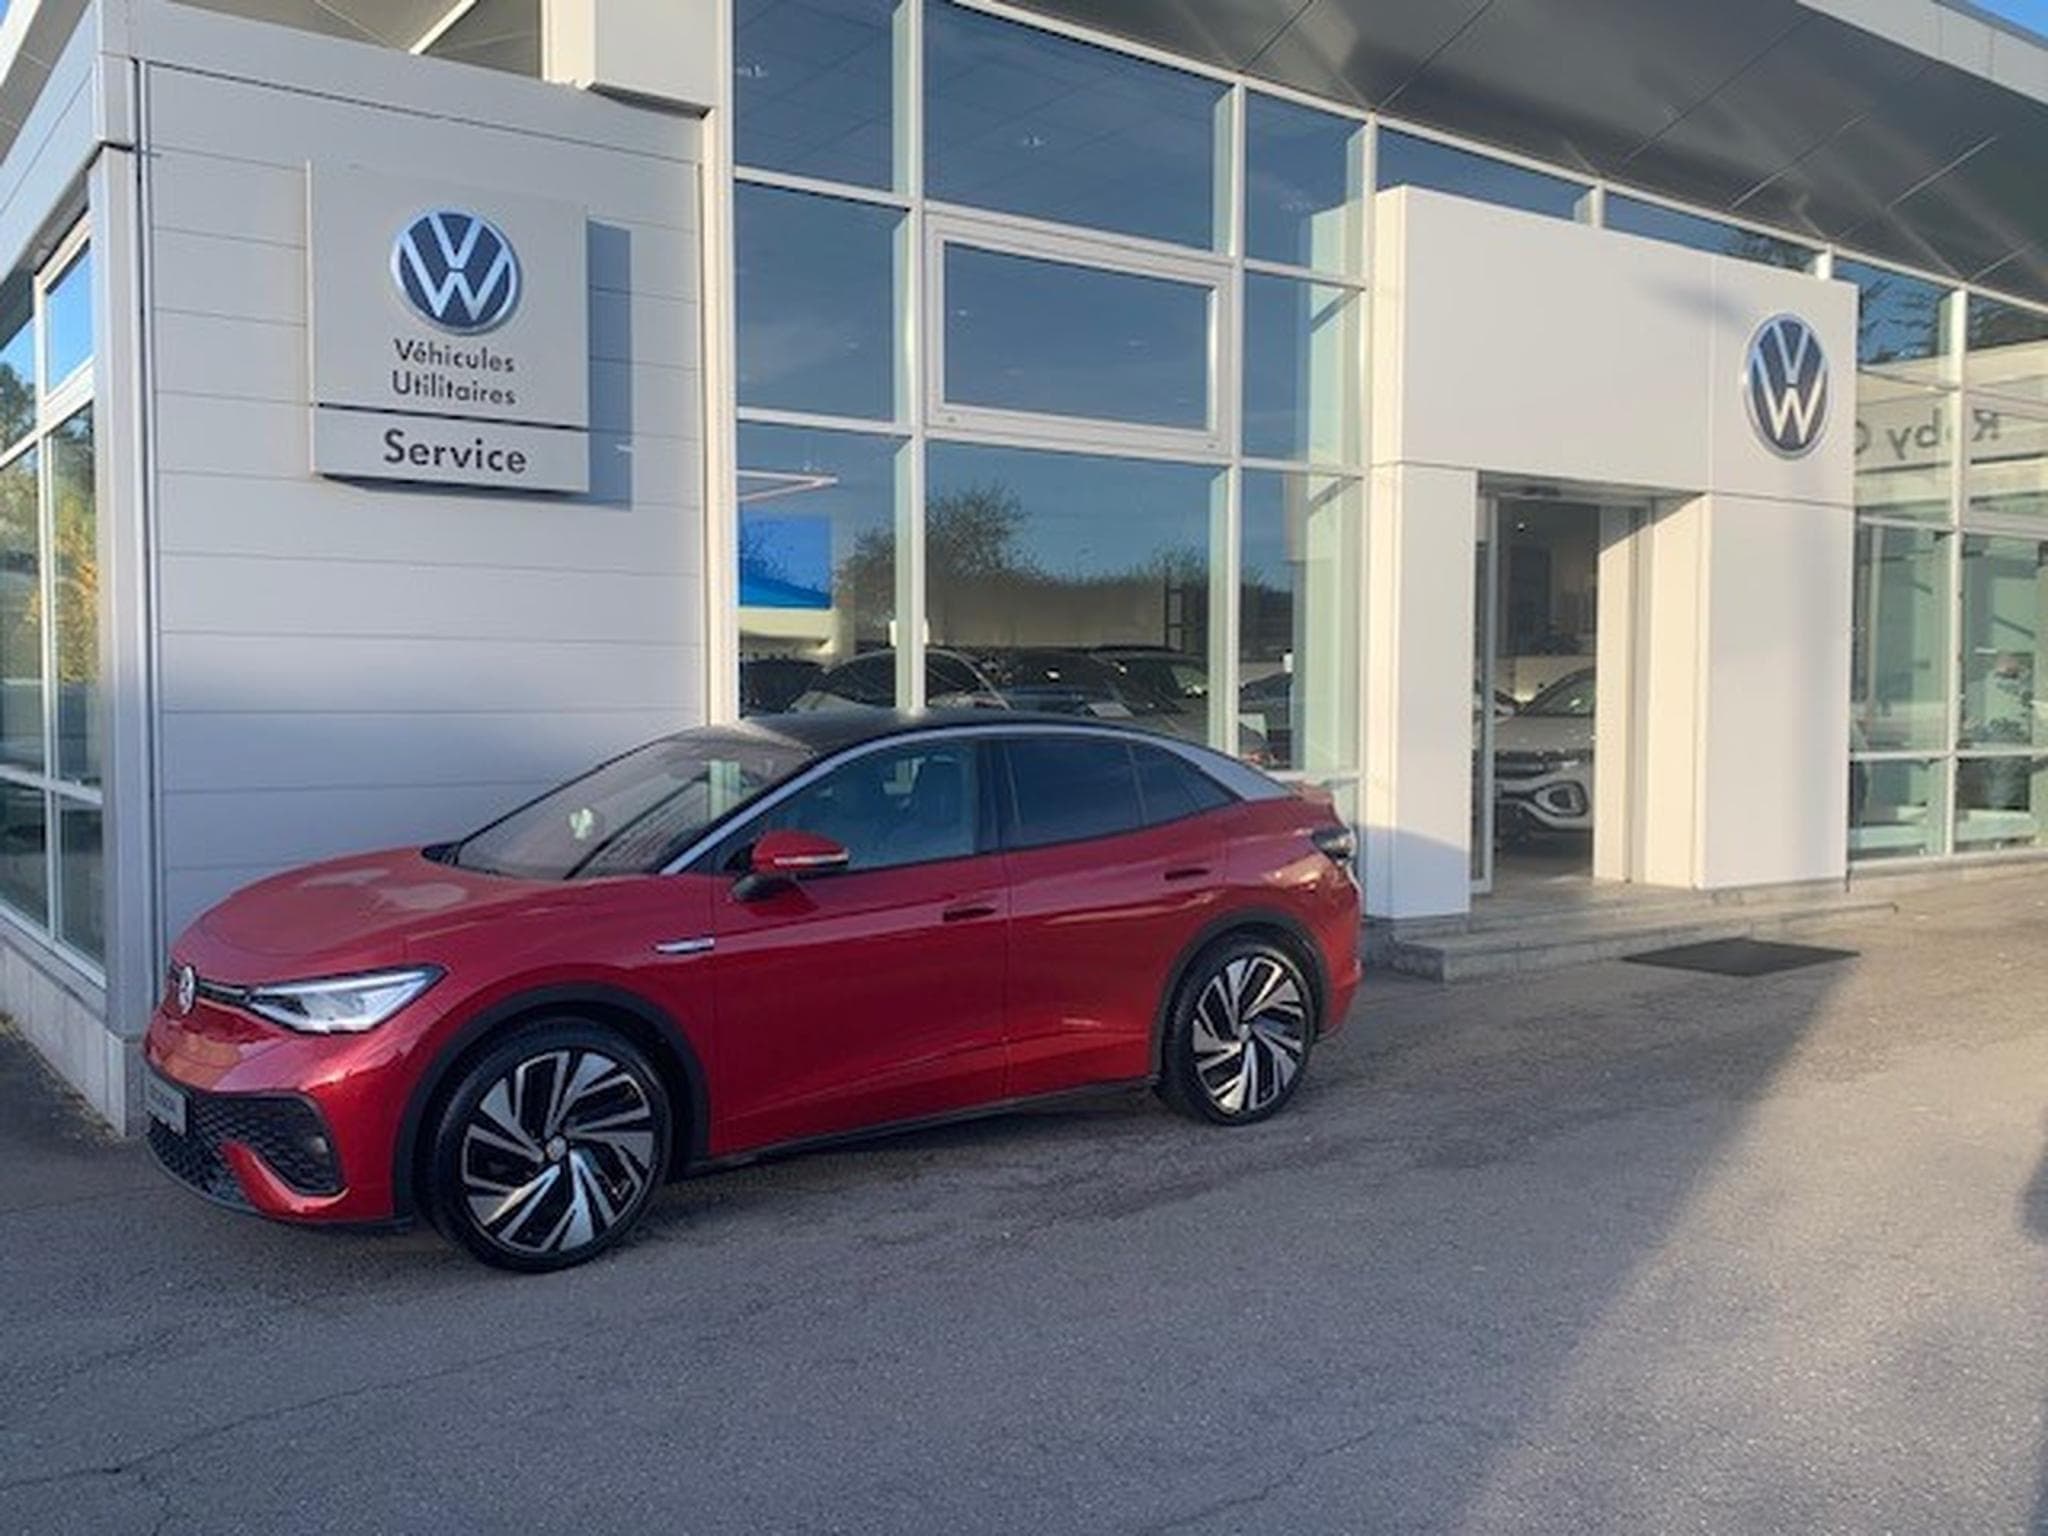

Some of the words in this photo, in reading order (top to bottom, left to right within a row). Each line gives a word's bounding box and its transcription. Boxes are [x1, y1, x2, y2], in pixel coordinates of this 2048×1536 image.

[394, 338, 516, 373] Véhicules
[391, 369, 517, 405] Utilitaires
[384, 428, 527, 474] Service
